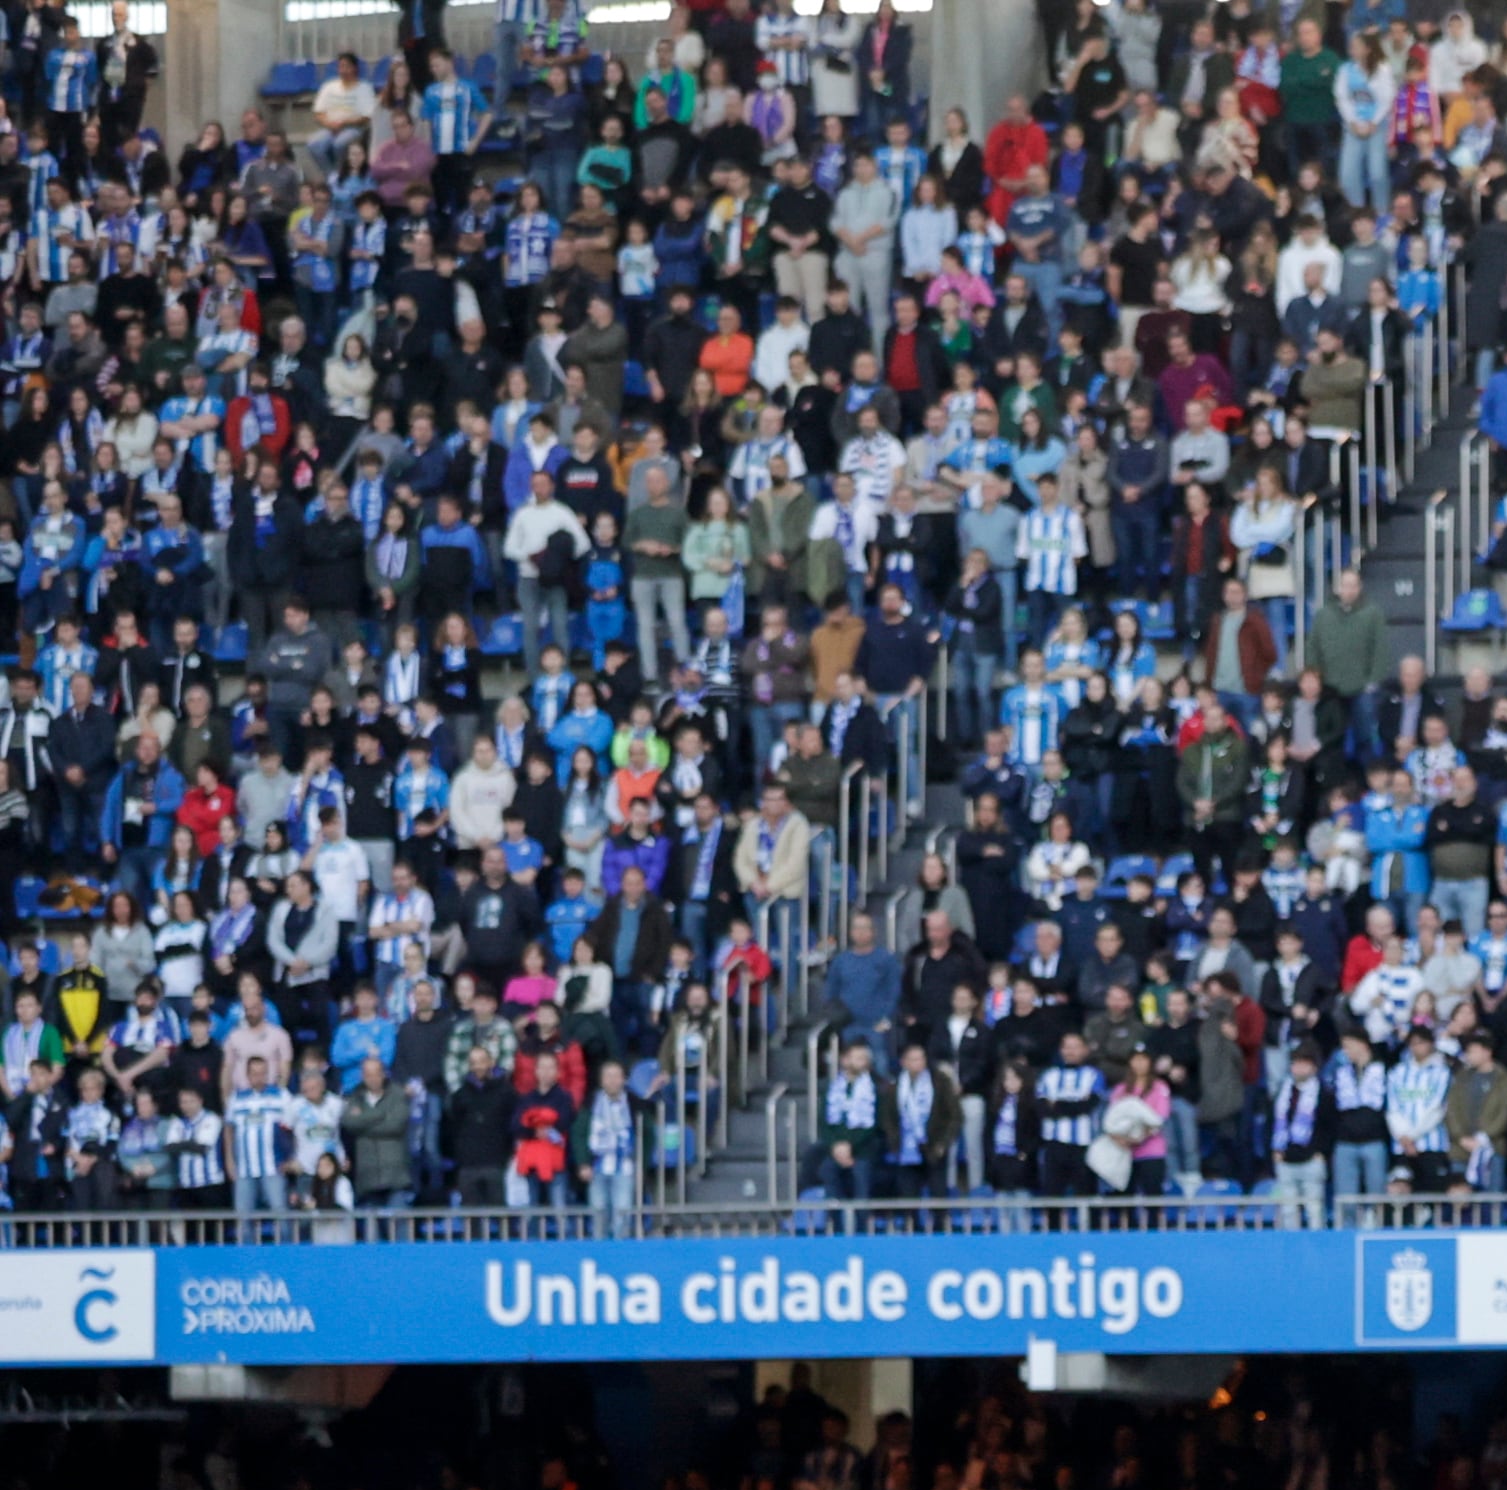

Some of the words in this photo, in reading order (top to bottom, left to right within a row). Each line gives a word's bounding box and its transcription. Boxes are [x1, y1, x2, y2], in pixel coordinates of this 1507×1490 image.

[181, 1273, 291, 1306] CORUÑA
[486, 1258, 661, 1326] Unha
[681, 1256, 907, 1324] cidade
[928, 1252, 1183, 1334] contigo
